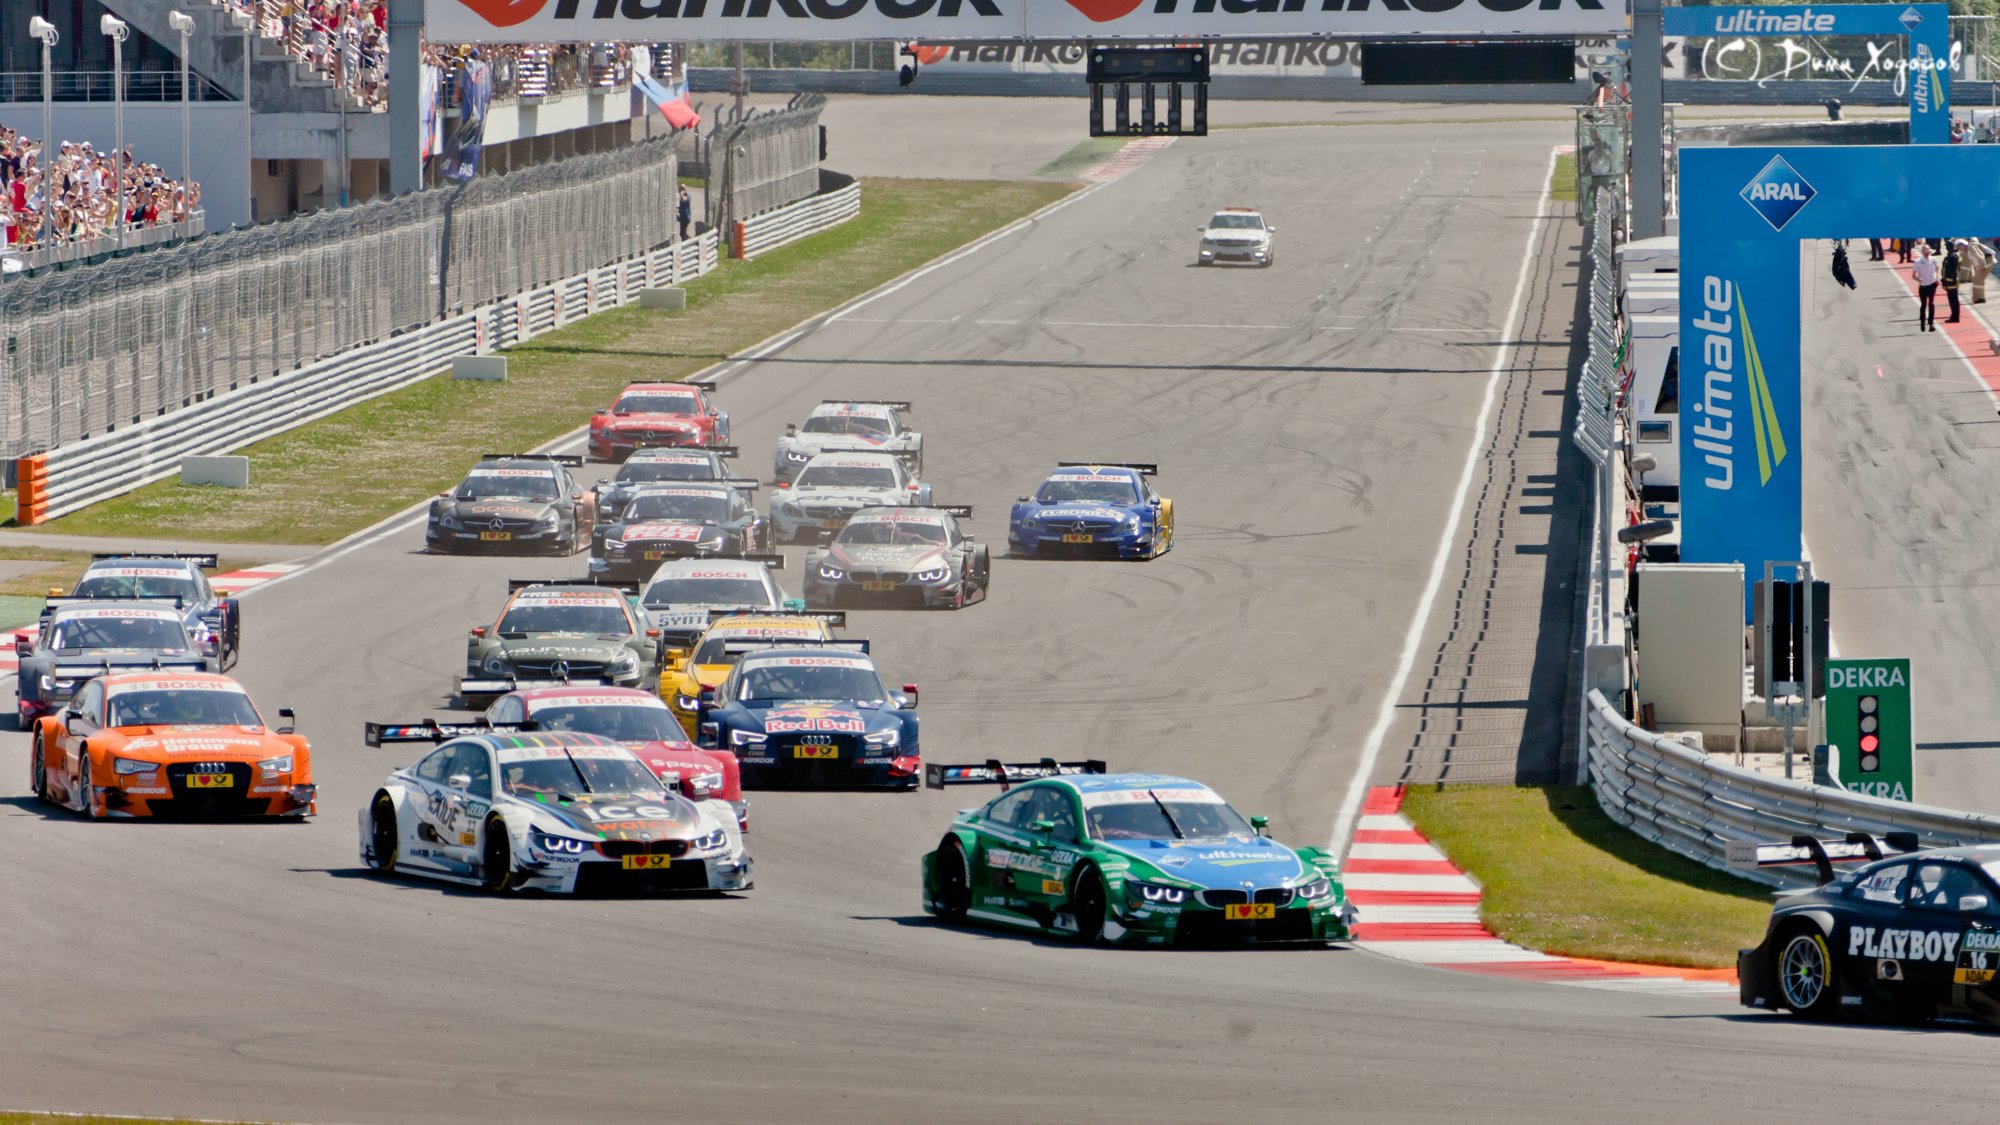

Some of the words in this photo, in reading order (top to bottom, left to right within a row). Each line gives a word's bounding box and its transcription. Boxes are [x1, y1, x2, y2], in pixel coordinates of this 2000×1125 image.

[1716, 9, 1835, 32] ultimate
[950, 44, 1087, 66] Hanko
[1211, 41, 1361, 67] Hanko
[1750, 182, 1806, 201] ARAL
[1694, 275, 1733, 491] ultimate
[120, 568, 177, 576] BOSCH
[659, 616, 703, 627] SYNT
[746, 628, 809, 636] BOSCH
[788, 658, 853, 666] BOSCH
[1829, 667, 1905, 689] DEKRA
[156, 681, 224, 690] BOSCH
[577, 697, 644, 706] BOSCH
[767, 719, 816, 733] Red
[818, 719, 864, 733] Bull
[162, 737, 260, 748] Hoffmann
[164, 743, 226, 753] Group
[545, 747, 616, 757] BOSCH
[650, 758, 714, 772] Sport
[1131, 790, 1207, 801] BOSCH
[1847, 781, 1908, 802] EKRA
[1008, 852, 1044, 870] EDGE
[1050, 850, 1073, 864] DEKRA
[1200, 850, 1292, 861] ultimate
[1848, 926, 1960, 962] PLAYBOY
[1966, 931, 2000, 949] DEKRA
[1970, 952, 1988, 970] 16
